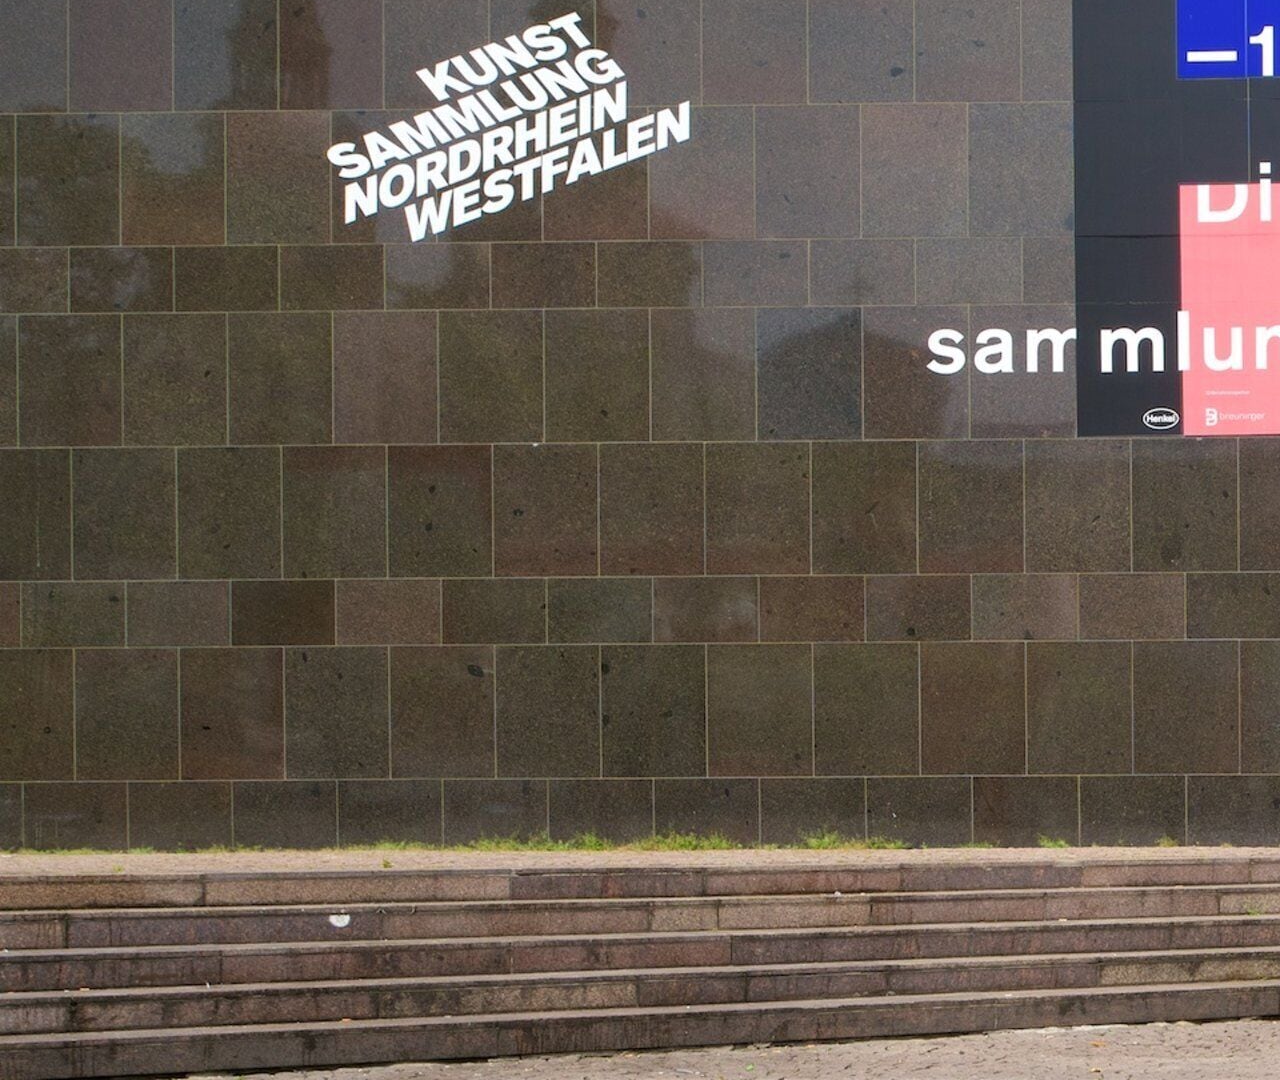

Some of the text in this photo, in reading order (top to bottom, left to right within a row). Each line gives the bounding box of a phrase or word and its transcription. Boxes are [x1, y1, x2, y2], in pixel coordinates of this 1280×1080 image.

[326, 48, 626, 179] SAMMLUNG
[416, 11, 591, 101] KUNST
[344, 80, 628, 225] NORDRHEIN
[404, 100, 691, 243] WESTFALEN
[1146, 414, 1176, 423] Henkel
